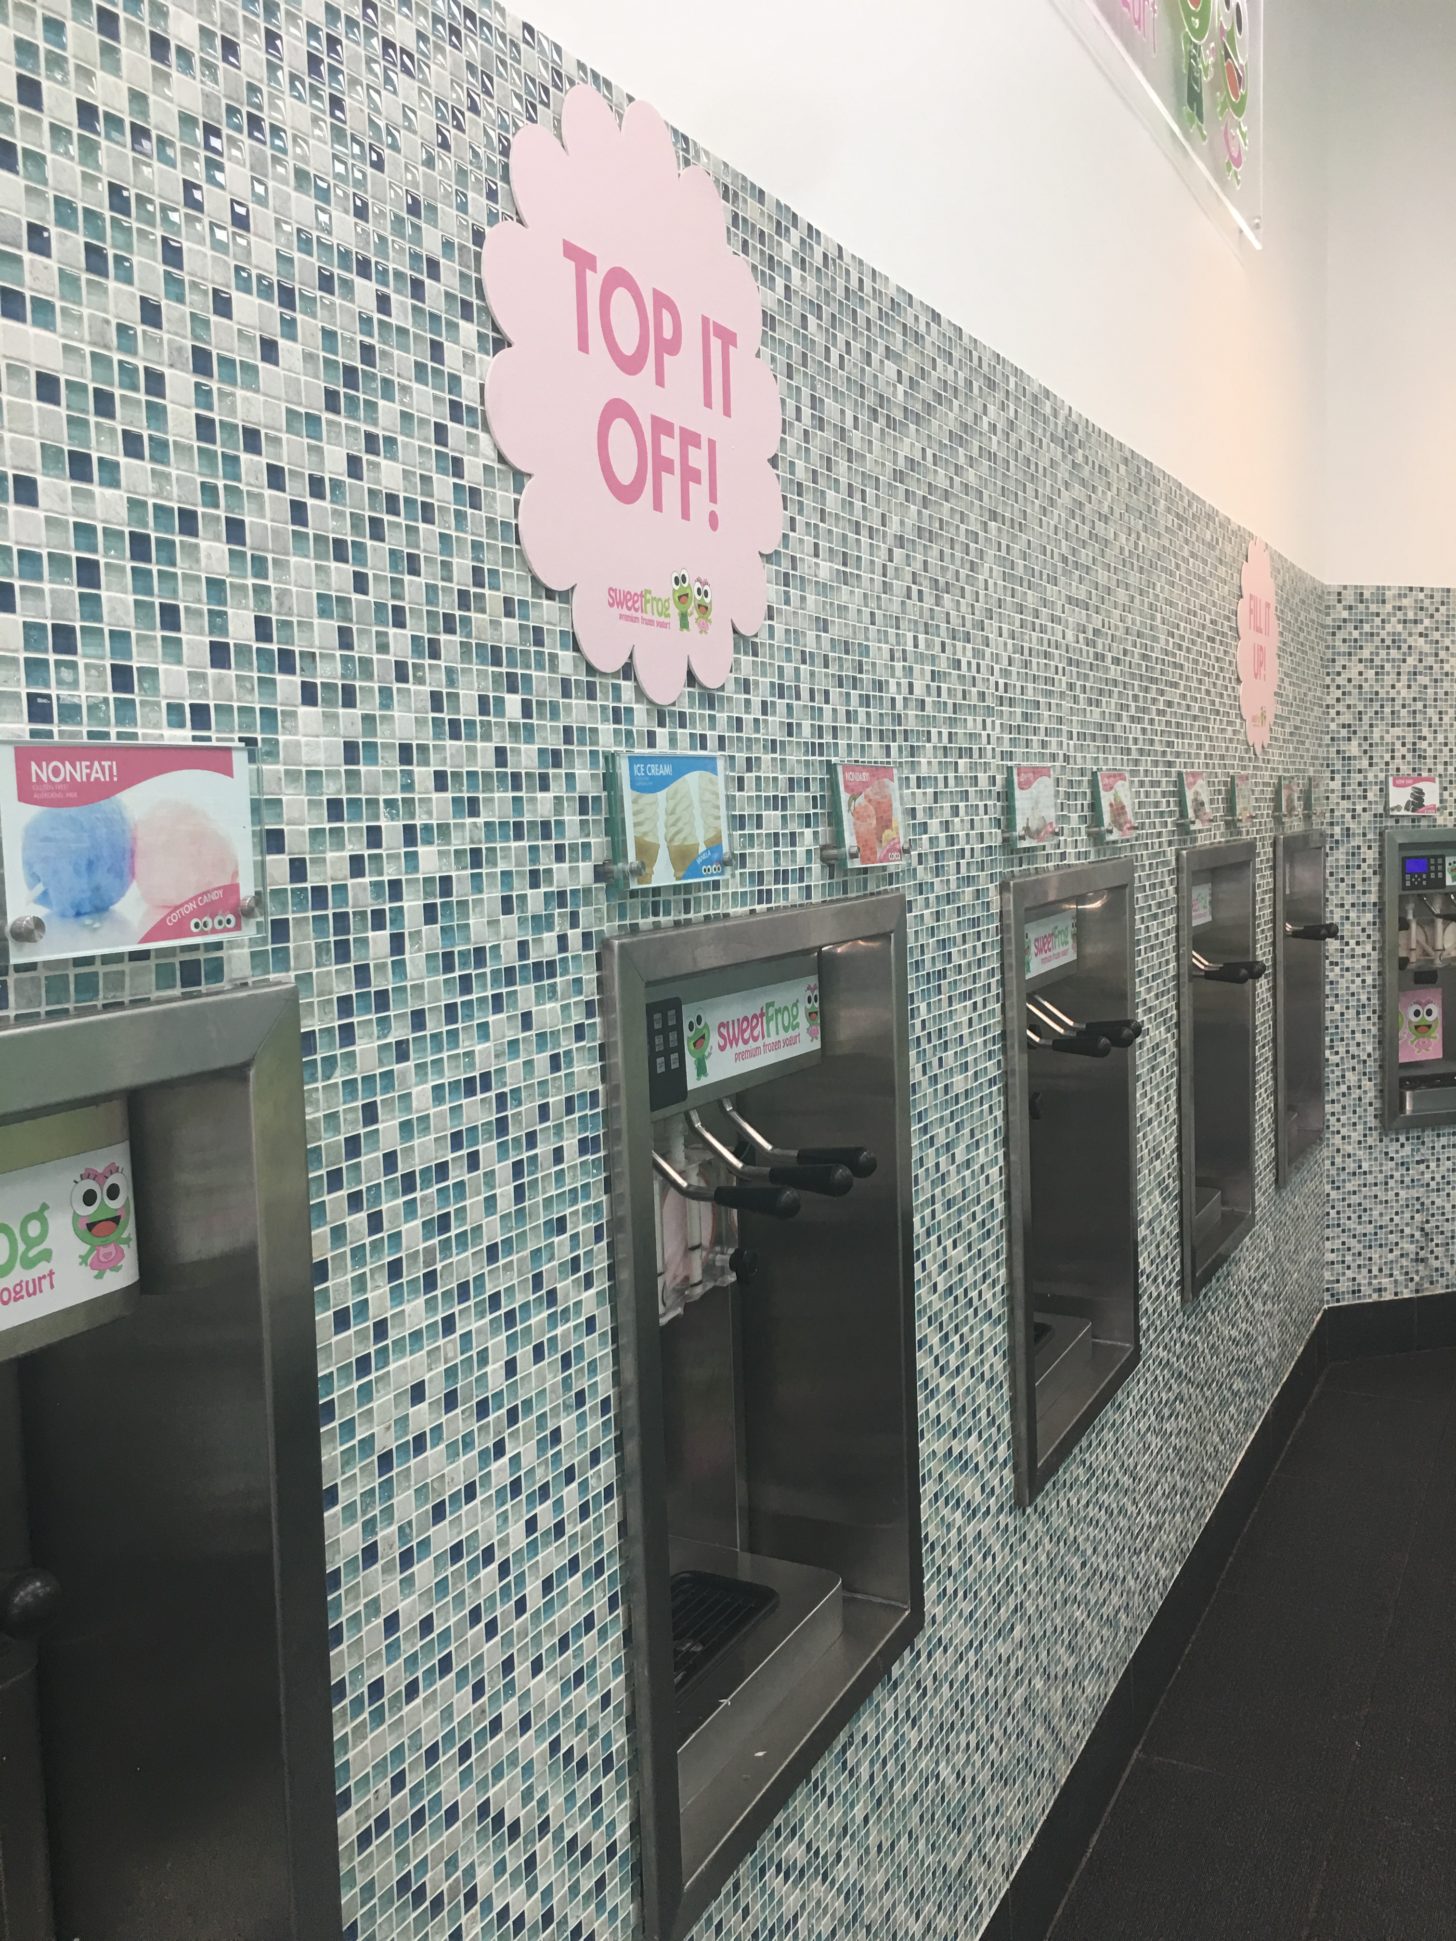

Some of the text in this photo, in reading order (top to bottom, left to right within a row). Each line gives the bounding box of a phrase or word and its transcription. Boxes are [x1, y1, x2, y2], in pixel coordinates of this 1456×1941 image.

[562, 238, 738, 419] TOP IT
[596, 397, 720, 533] OFF!
[31, 760, 118, 783] NONFAT!
[633, 763, 673, 776] ICE CREAM!
[166, 889, 224, 926] COTTON CANDY
